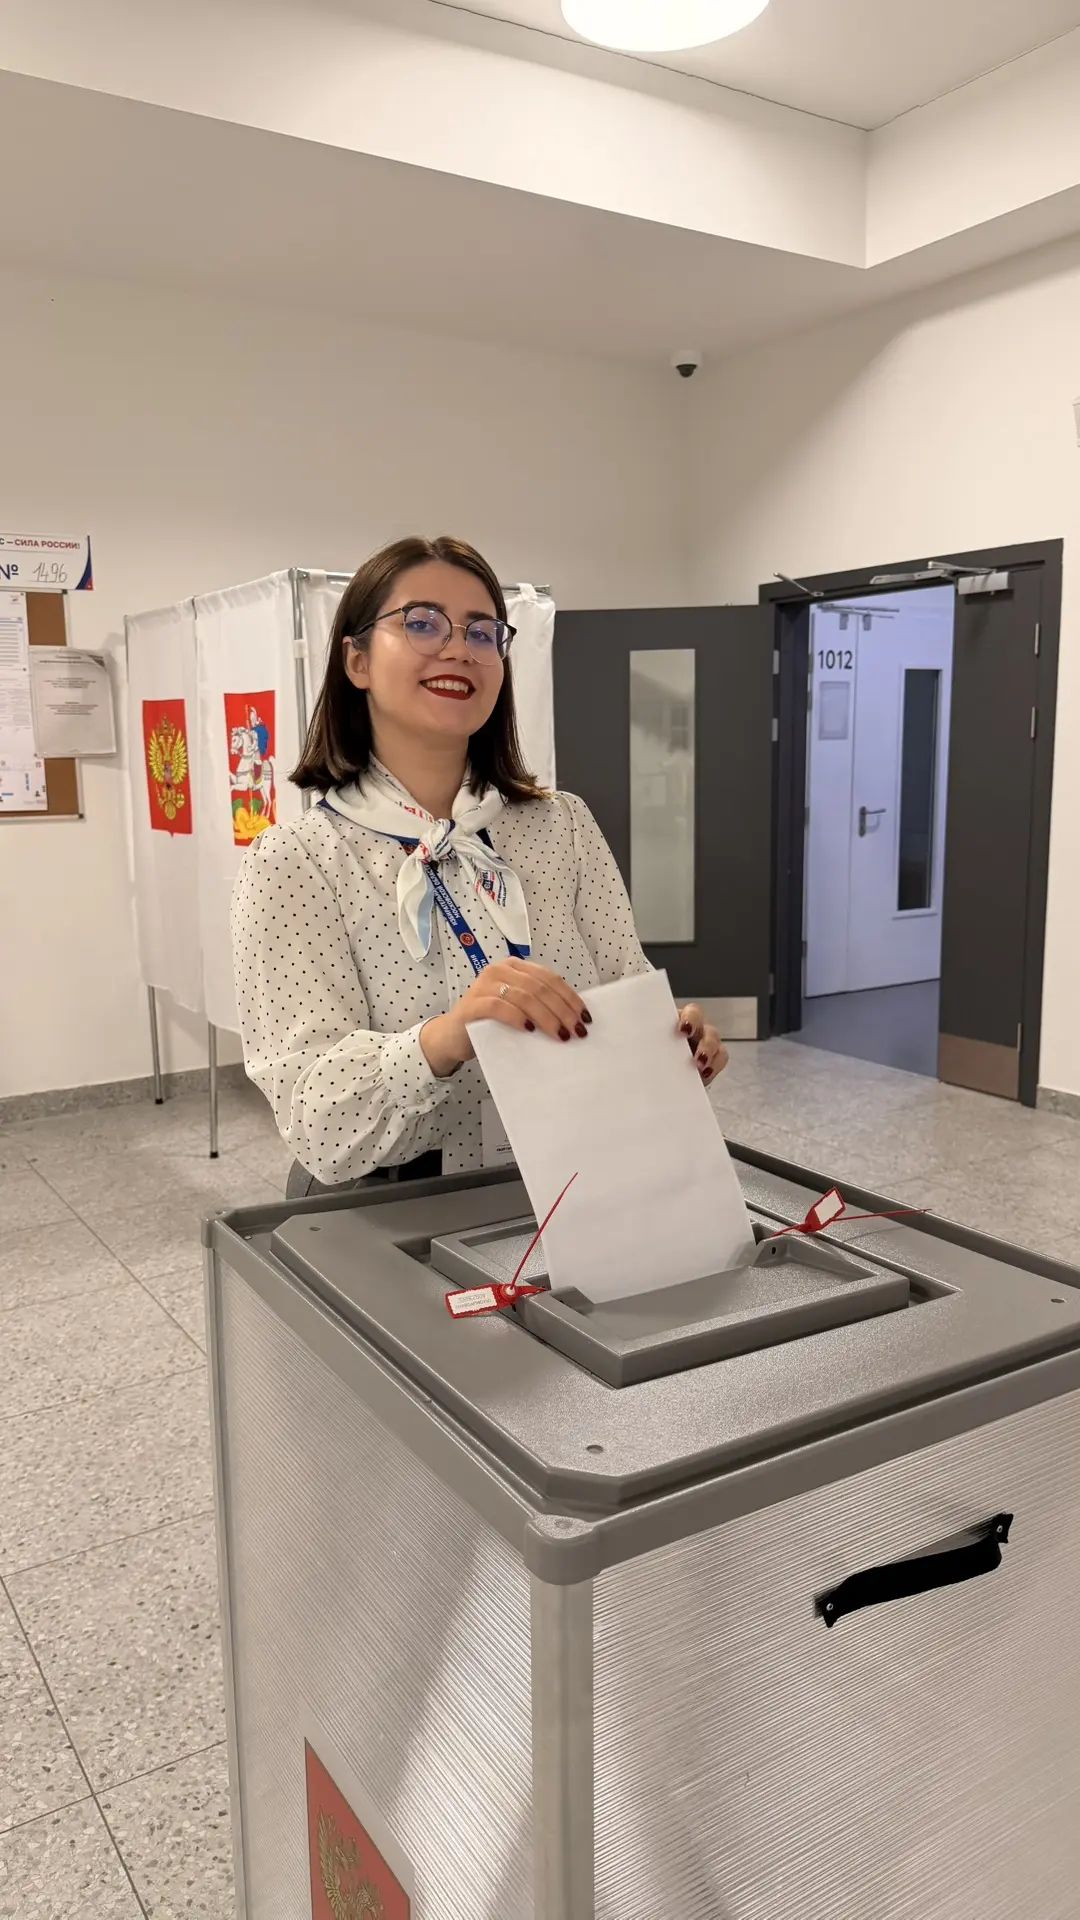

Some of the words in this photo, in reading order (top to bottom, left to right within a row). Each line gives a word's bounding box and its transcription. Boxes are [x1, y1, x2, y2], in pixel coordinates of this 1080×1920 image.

[15, 539, 39, 547] СИЛА
[41, 540, 80, 550] РОССИИ!
[32, 562, 67, 583] 1496
[818, 650, 853, 670] 1012
